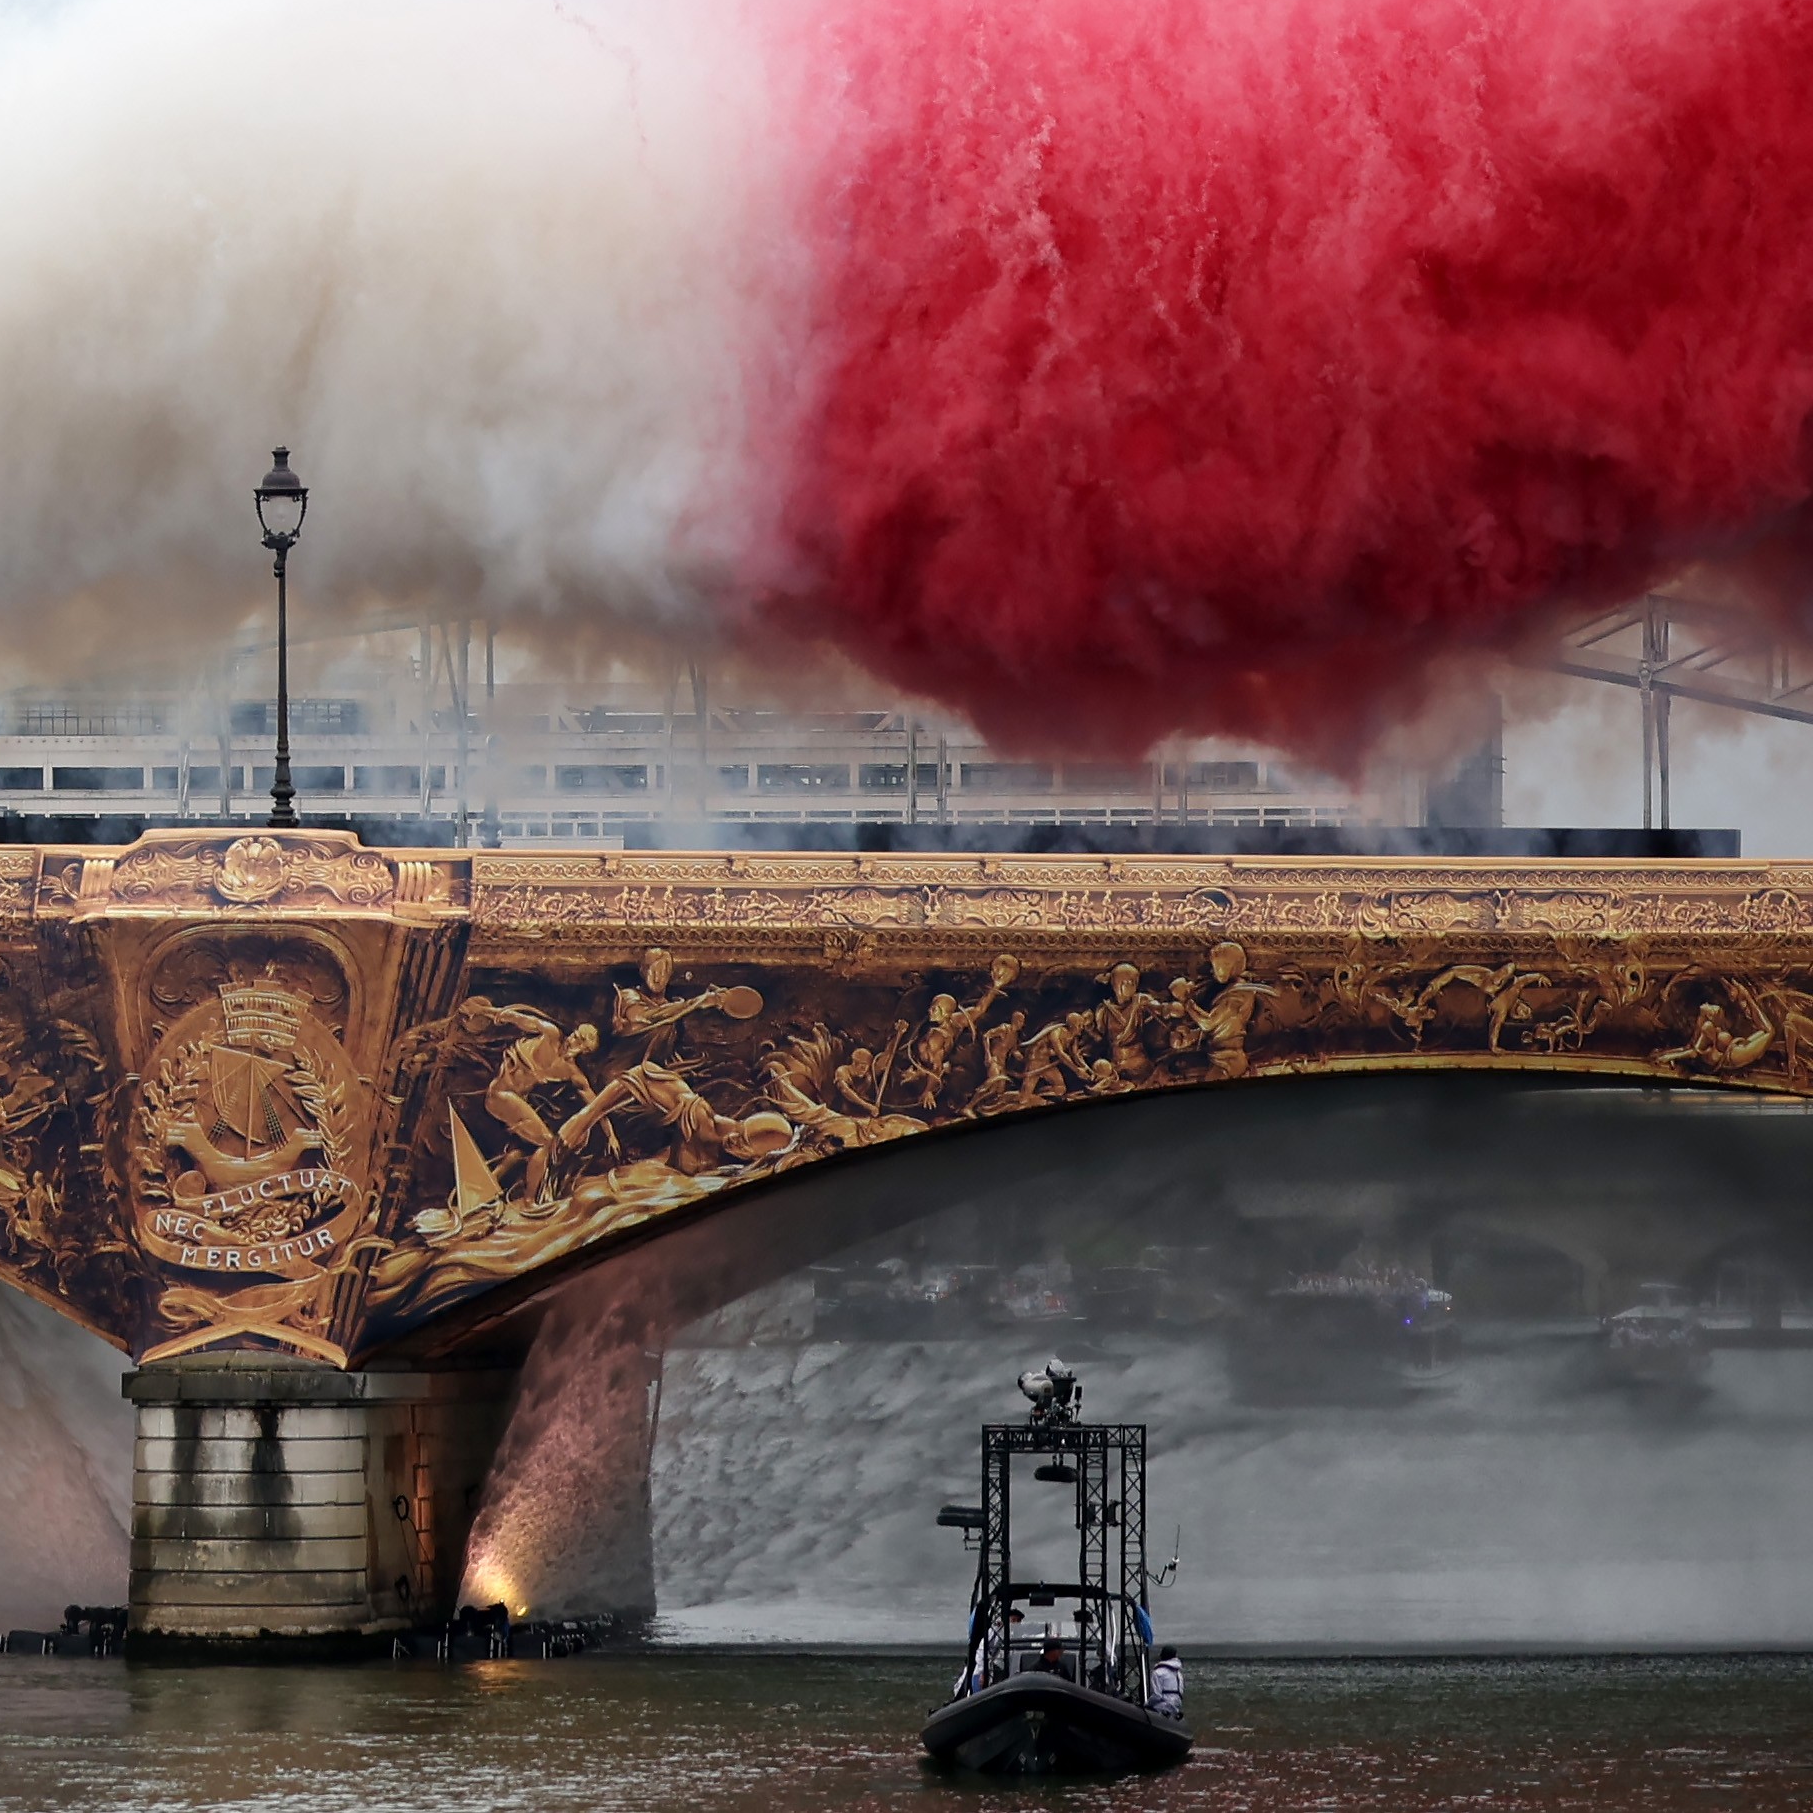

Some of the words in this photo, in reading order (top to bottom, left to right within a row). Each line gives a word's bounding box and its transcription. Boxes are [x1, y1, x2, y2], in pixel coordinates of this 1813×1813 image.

[201, 1170, 351, 1217] FLUCTUAT
[156, 1213, 207, 1240] NEC
[180, 1229, 335, 1268] MERGITUR
